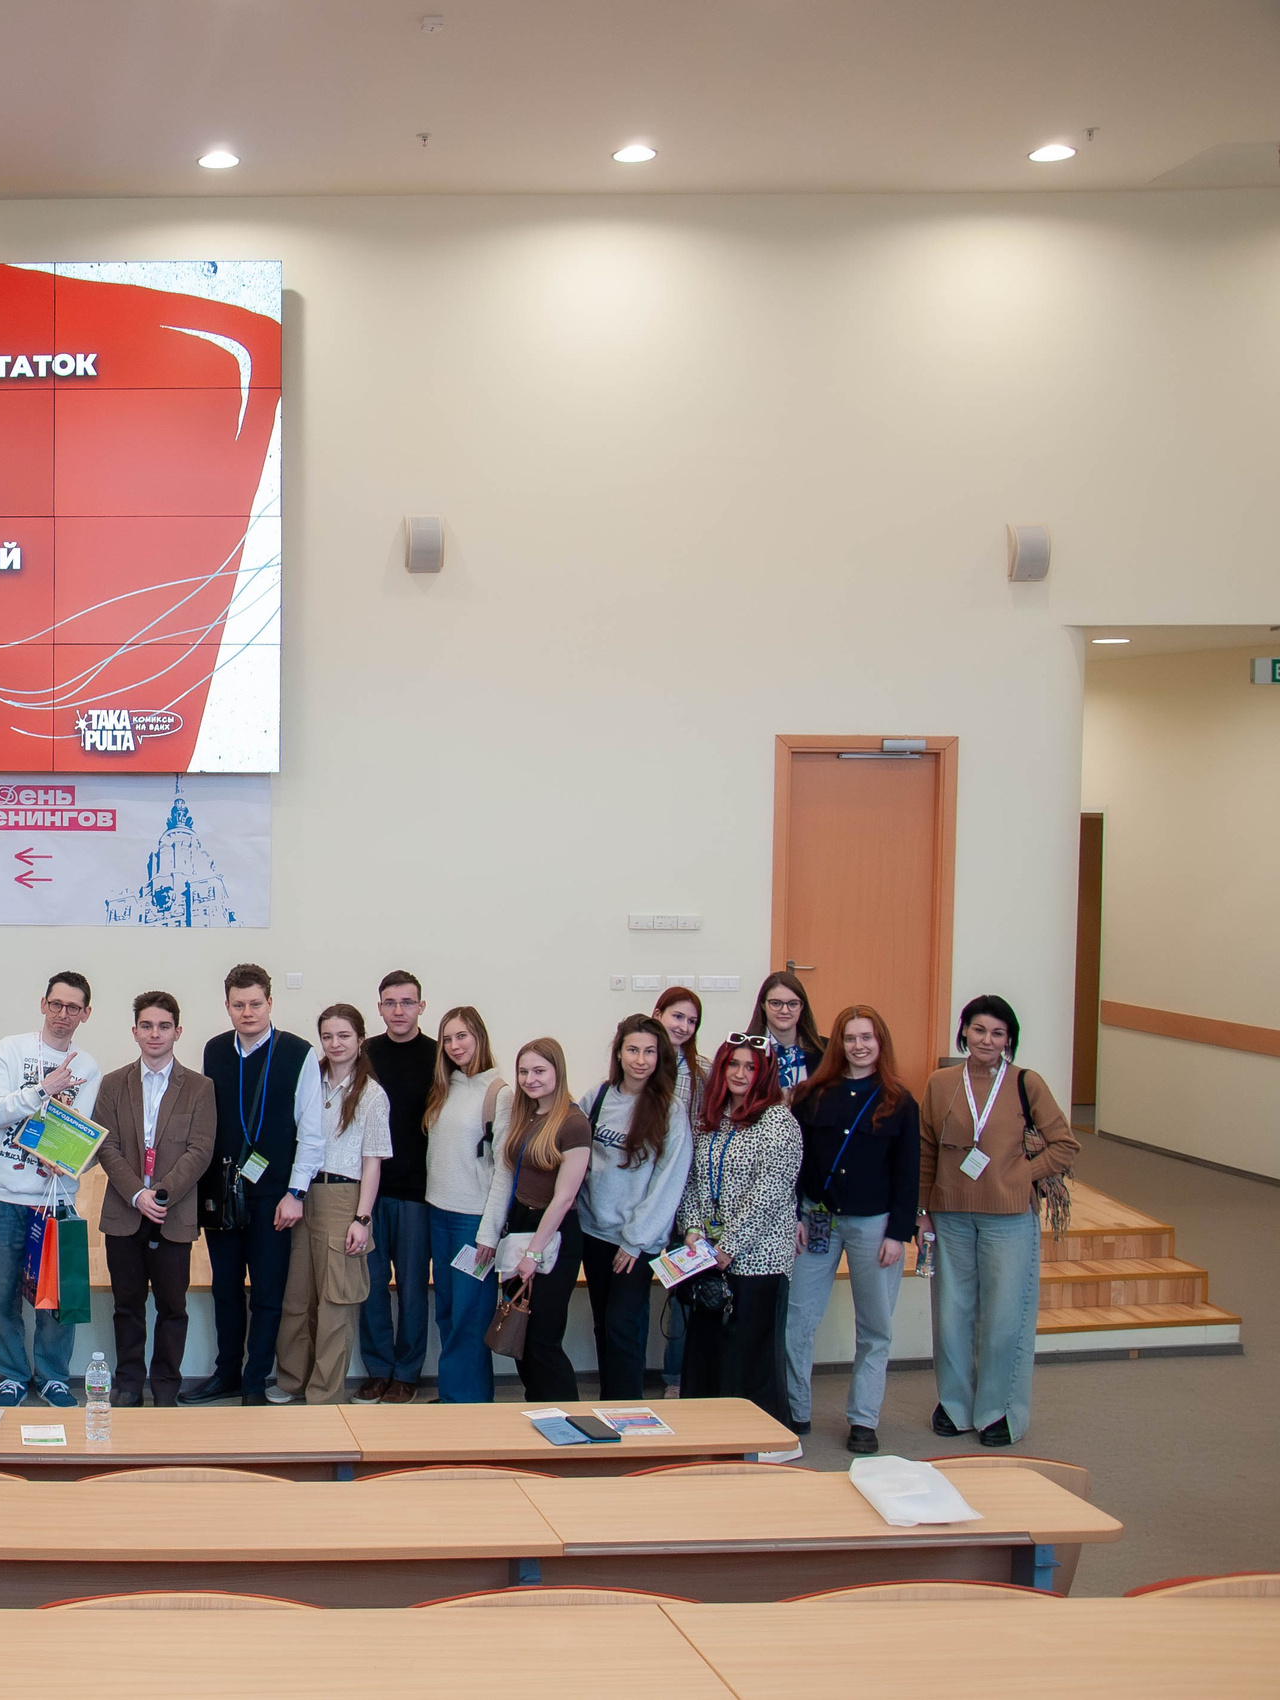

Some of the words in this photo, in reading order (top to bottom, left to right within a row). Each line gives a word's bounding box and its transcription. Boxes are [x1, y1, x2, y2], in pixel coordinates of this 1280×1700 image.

[88, 709, 131, 730] TAKA
[132, 715, 175, 723] КОМИКСЫ
[85, 730, 135, 751] PULTA
